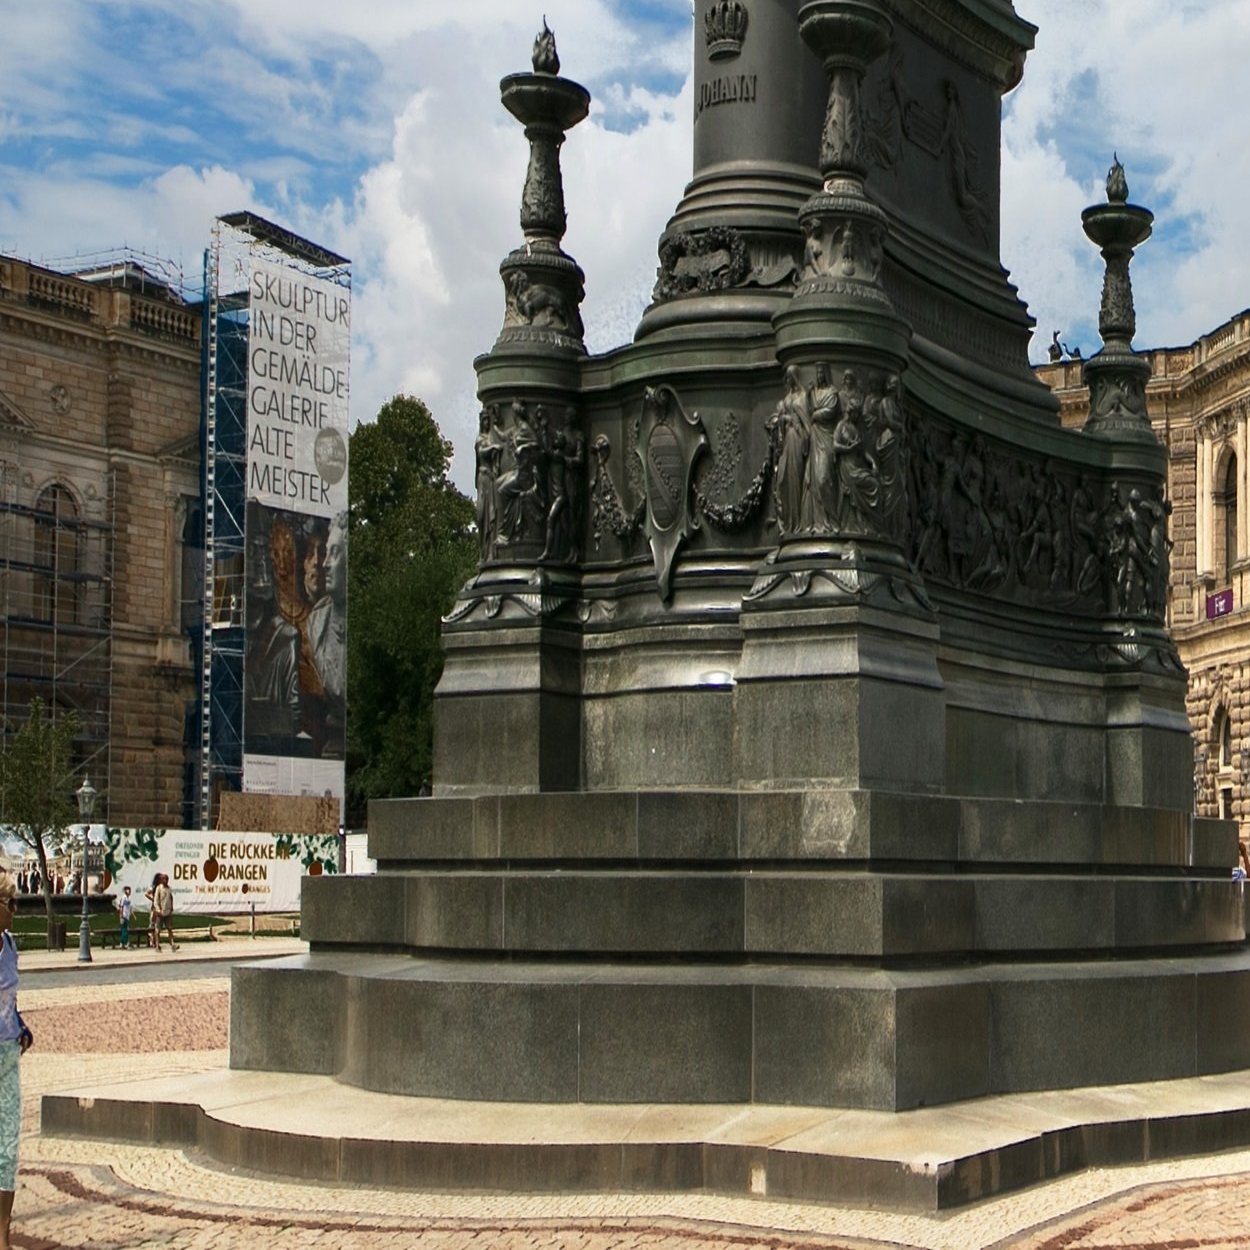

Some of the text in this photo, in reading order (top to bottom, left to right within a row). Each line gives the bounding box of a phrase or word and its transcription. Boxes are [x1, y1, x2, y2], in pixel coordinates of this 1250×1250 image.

[697, 74, 757, 113] JOHANN
[253, 271, 349, 328] SKULPTUR
[253, 308, 317, 354] IN DER
[250, 424, 294, 460] ALTE
[250, 461, 331, 506] MEISTER
[208, 842, 228, 860] DIE
[173, 863, 198, 880] DER
